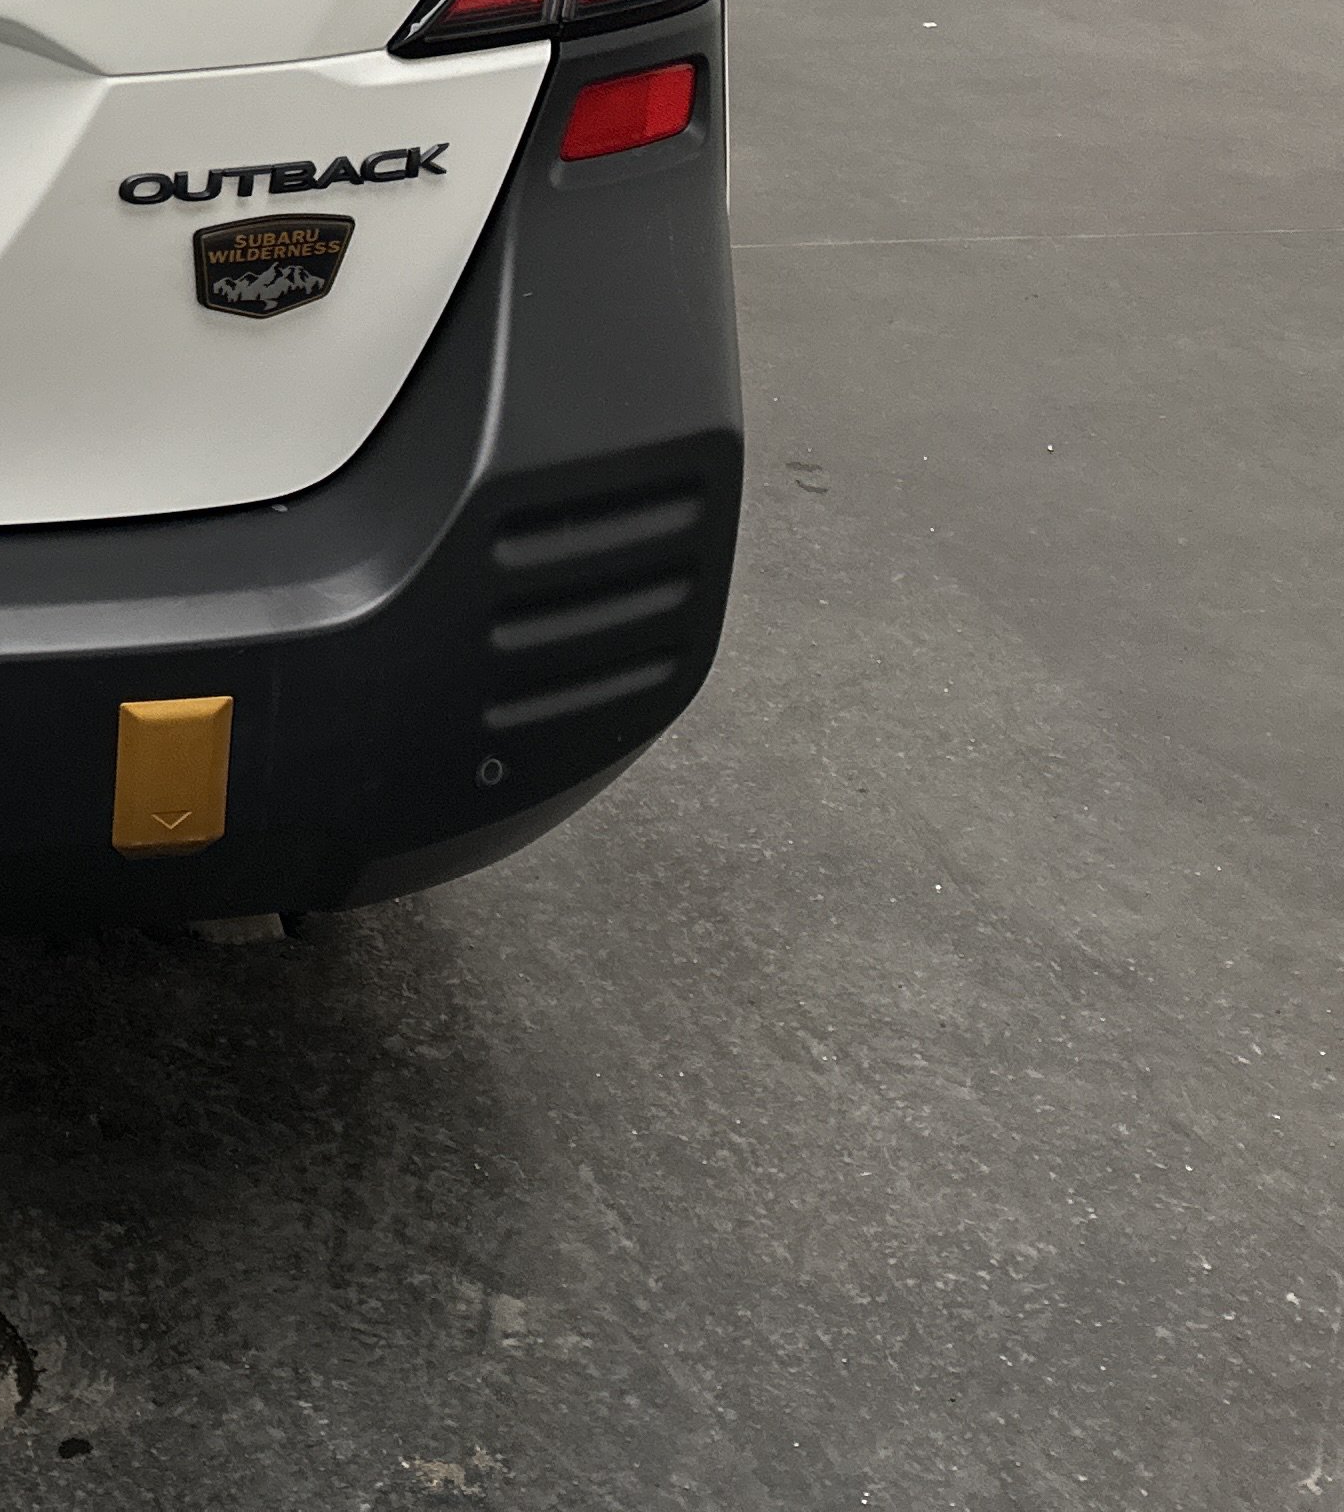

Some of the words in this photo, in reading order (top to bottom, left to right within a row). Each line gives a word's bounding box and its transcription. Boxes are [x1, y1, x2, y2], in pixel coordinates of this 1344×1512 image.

[119, 142, 450, 204] OUTBACK
[234, 228, 320, 249] SUBARU
[209, 239, 341, 263] WILDERNESS
